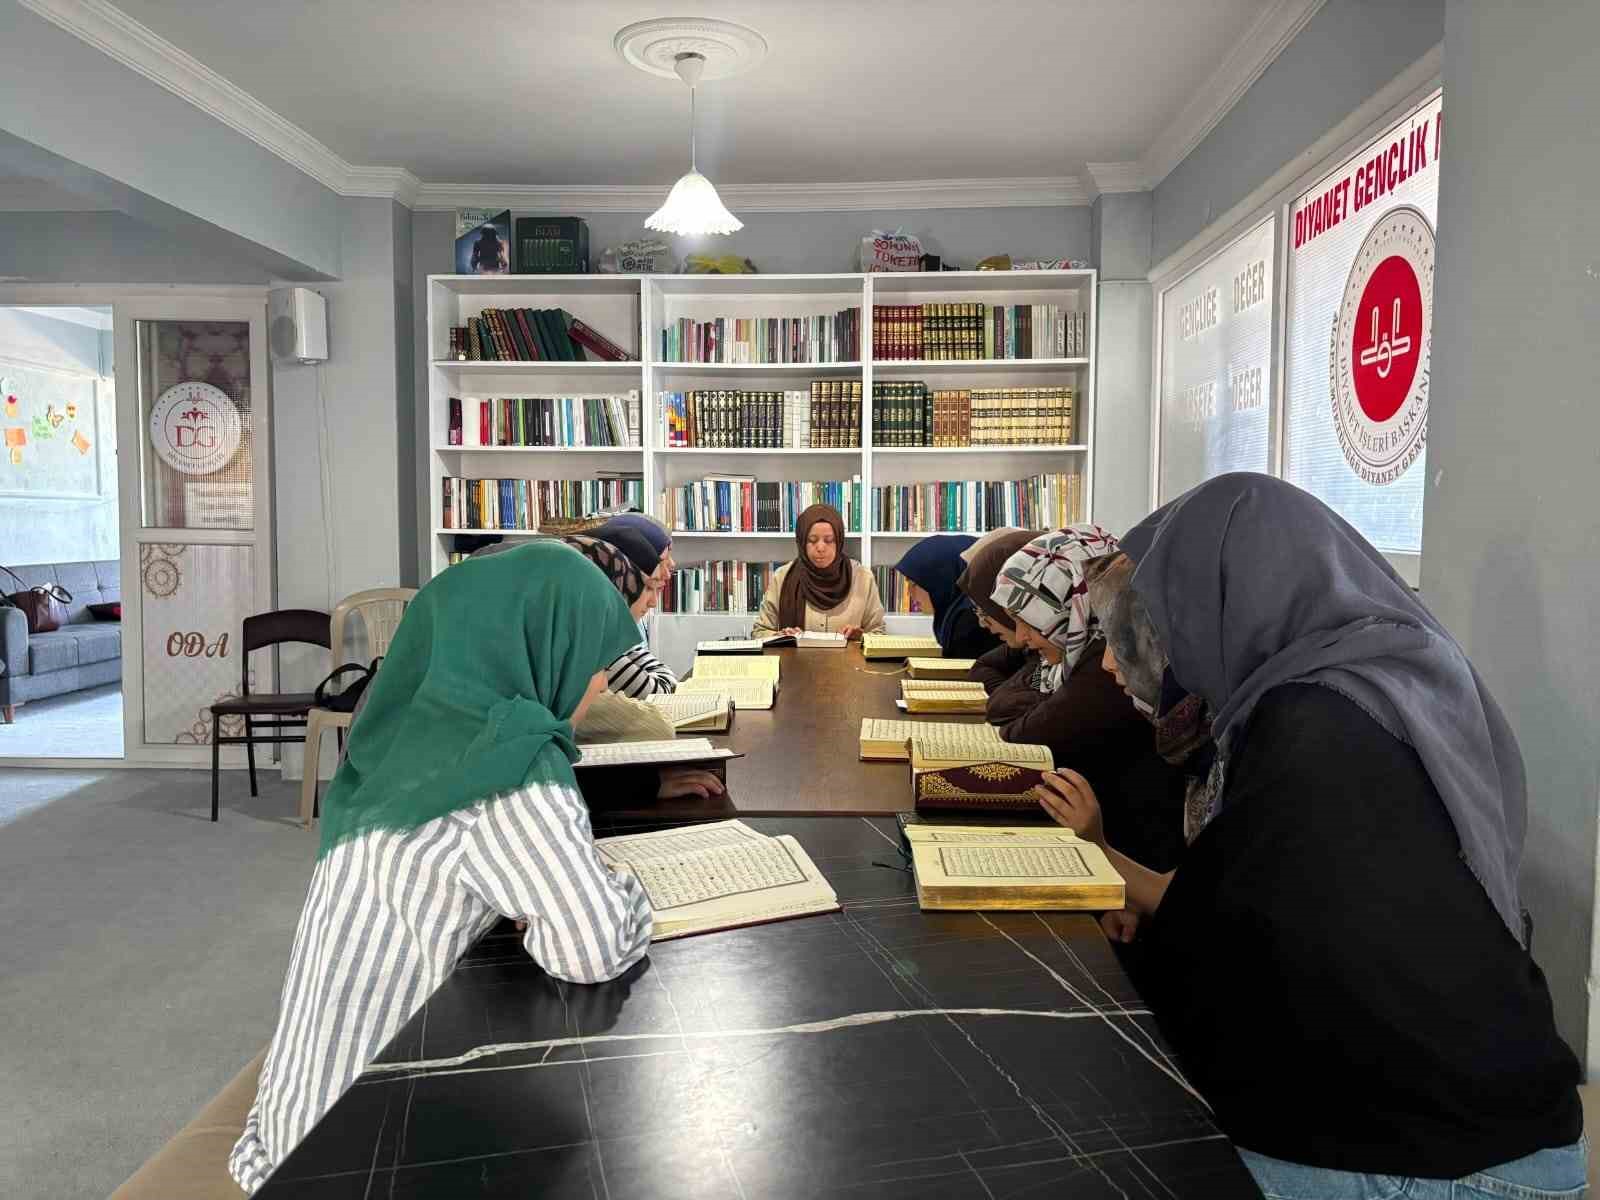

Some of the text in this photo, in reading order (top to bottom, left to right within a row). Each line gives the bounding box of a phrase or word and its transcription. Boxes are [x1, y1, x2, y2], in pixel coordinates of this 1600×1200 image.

[1295, 176, 1350, 248] DİYANET
[1353, 119, 1429, 213] GENÇLİK
[1233, 260, 1264, 313] DEĞER
[1232, 365, 1262, 411] DEĞER
[166, 631, 230, 658] ODA
